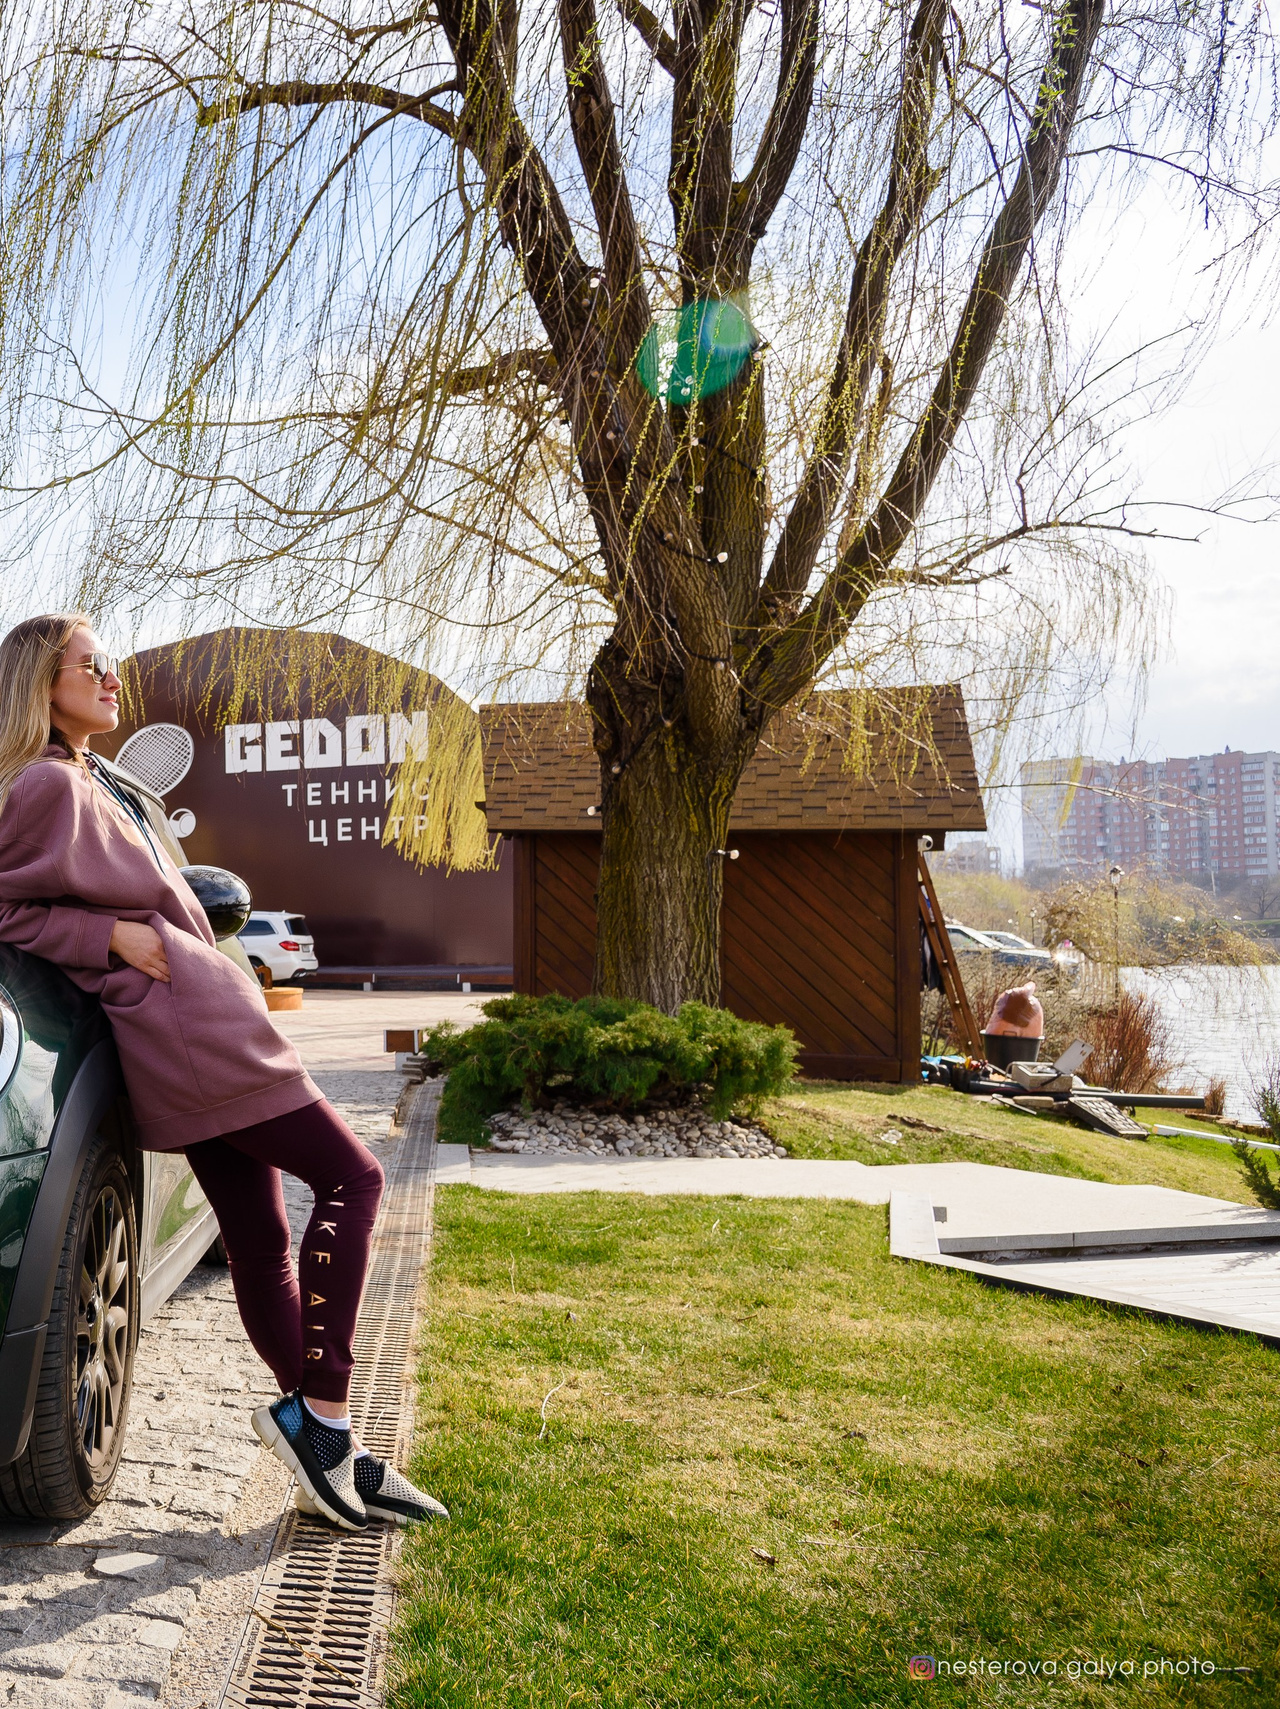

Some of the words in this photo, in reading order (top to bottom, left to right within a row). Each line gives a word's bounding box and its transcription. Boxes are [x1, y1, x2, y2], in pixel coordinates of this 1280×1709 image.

[224, 710, 429, 774] GEDON
[308, 814, 429, 846] ЦЕНТР
[307, 1290, 327, 1361] AIR
